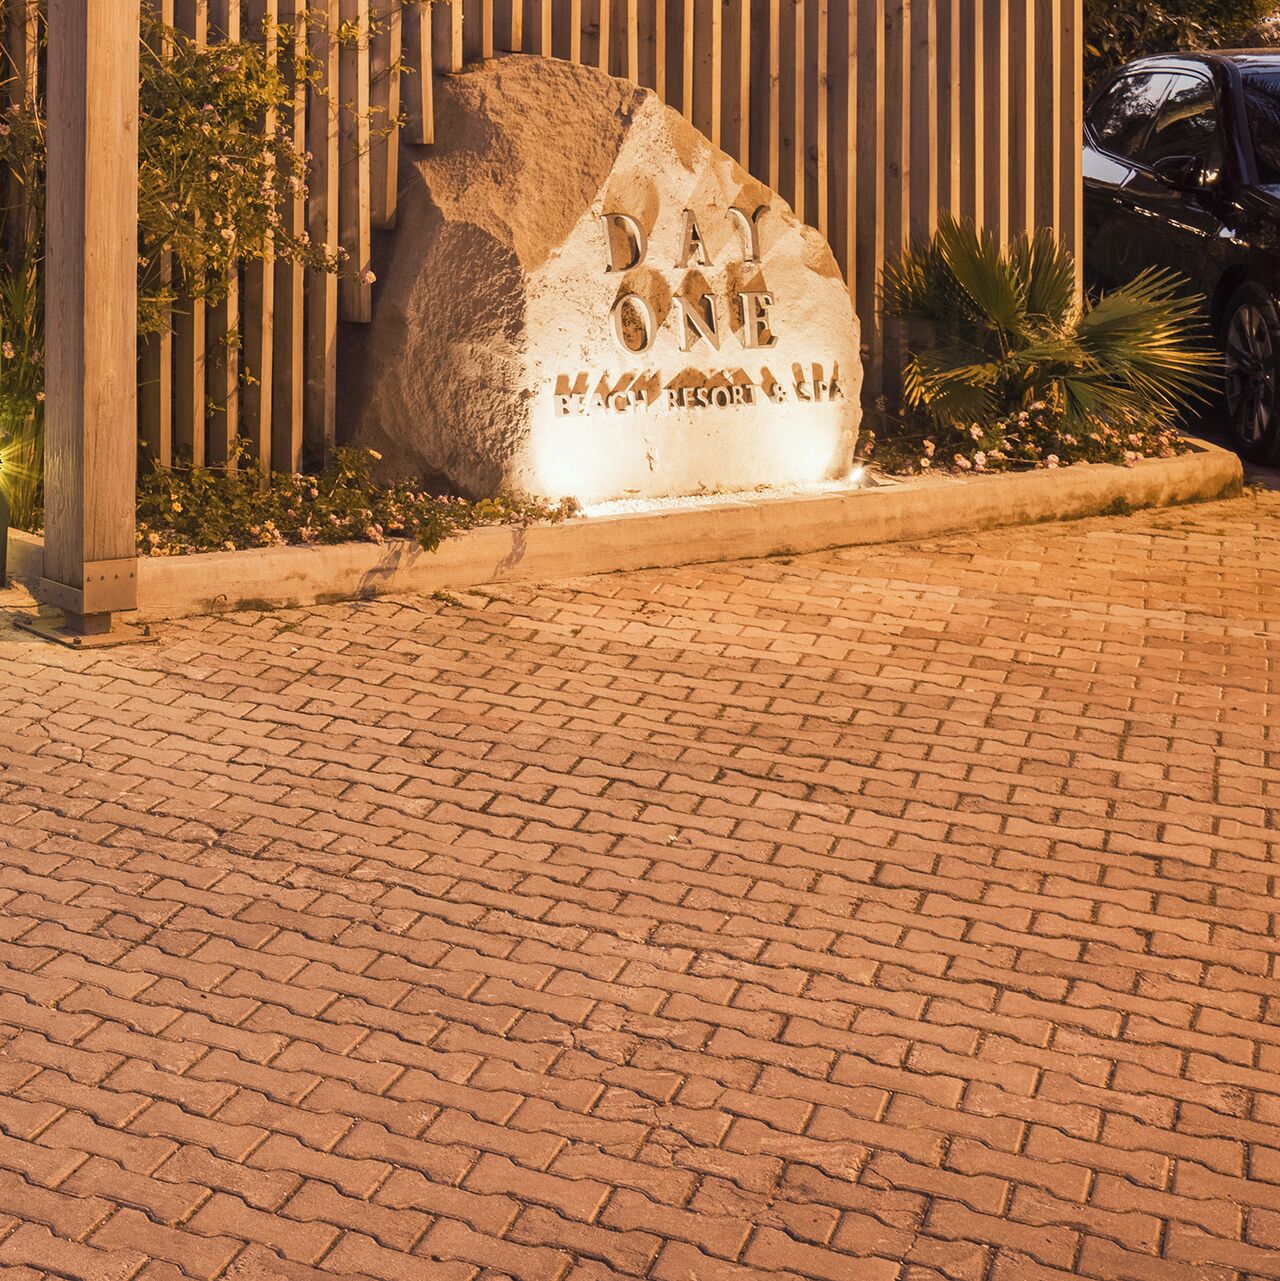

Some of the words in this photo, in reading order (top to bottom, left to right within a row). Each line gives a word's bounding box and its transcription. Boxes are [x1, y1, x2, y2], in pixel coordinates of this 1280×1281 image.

[600, 204, 772, 273] DAY
[608, 290, 780, 355] ONE
[553, 390, 649, 418] BEACH
[662, 382, 760, 413] RESORT
[769, 382, 787, 405] &
[792, 378, 844, 404] SPA
